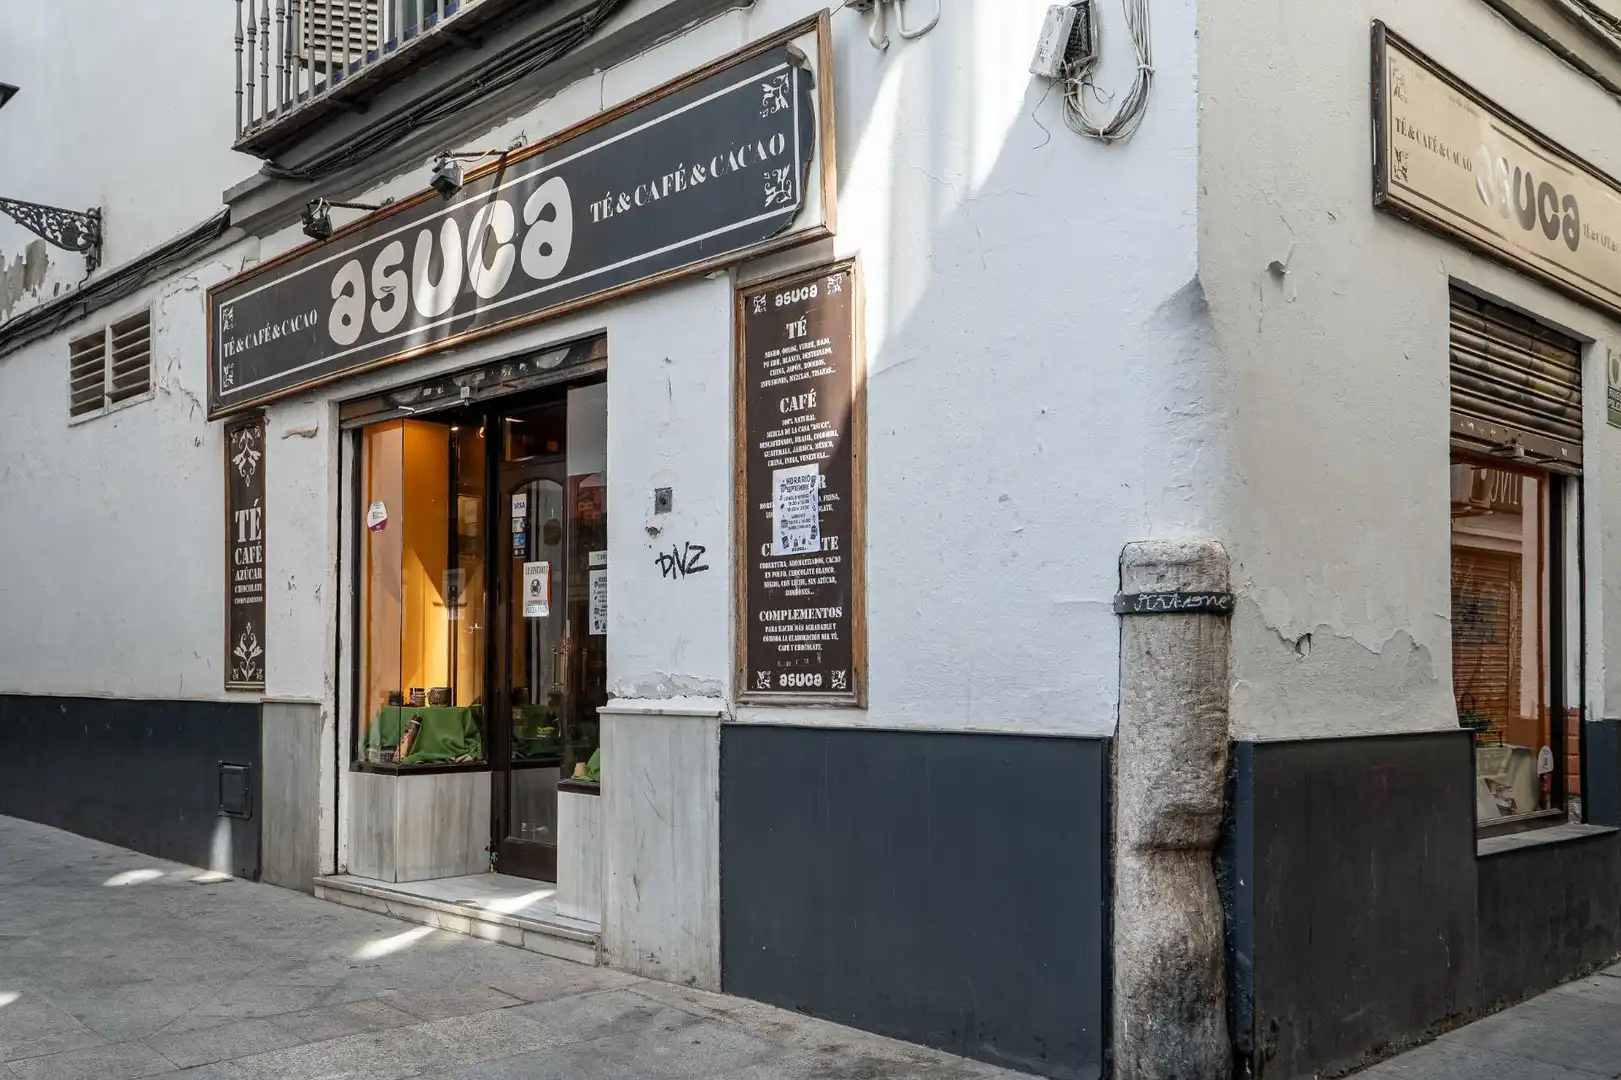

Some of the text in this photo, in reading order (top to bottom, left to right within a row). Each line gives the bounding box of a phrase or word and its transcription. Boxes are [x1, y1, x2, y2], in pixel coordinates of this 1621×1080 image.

[328, 176, 573, 345] asuca
[775, 284, 818, 307] asuca
[786, 316, 807, 340] TÉ
[780, 388, 817, 413] CAFÉ
[791, 427, 797, 435] LA
[798, 424, 810, 433] CASA
[786, 474, 811, 485] HORARIO
[514, 502, 525, 510] VISA
[235, 498, 261, 542] TÉ
[235, 541, 262, 565] CAFÉ
[235, 567, 262, 581] AZÚCAR
[235, 583, 262, 593] CHOCOLATE
[234, 596, 262, 604] COMPLEMENTOS
[759, 606, 842, 622] COMPLEMENTOS
[794, 623, 804, 631] MÁS
[805, 623, 832, 631] AGRADABLE
[789, 633, 820, 641] ELABORACIÓN
[778, 644, 790, 652] CAFÉ
[780, 673, 822, 687] asuca
